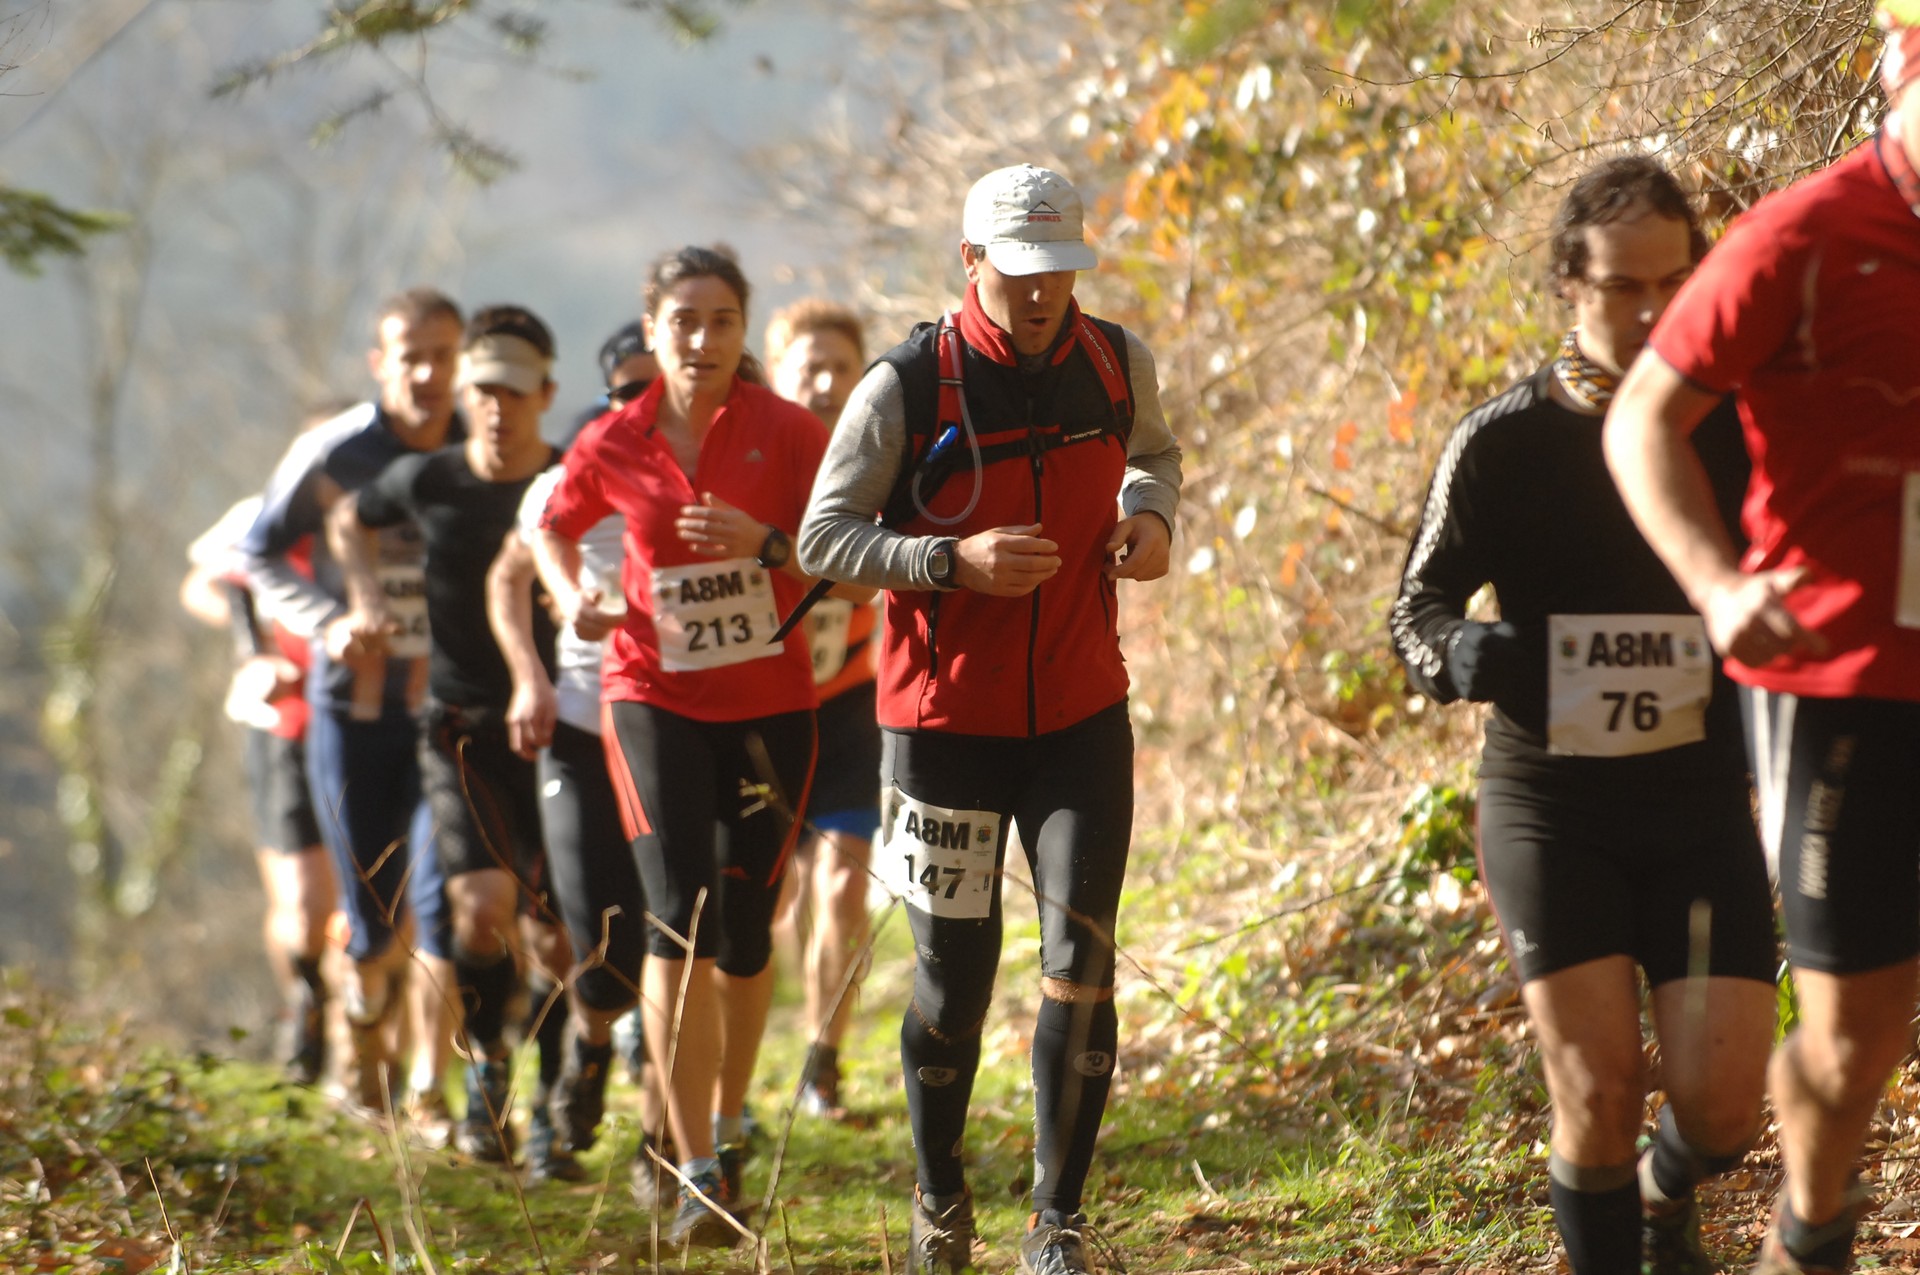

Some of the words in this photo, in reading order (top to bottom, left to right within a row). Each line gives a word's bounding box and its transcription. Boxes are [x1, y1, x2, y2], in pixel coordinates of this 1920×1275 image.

[680, 570, 745, 604] A8M
[685, 613, 753, 652] 213
[1587, 631, 1675, 668] A8M
[1601, 691, 1661, 732] 76
[904, 810, 971, 850] A8M
[904, 853, 967, 899] 147
